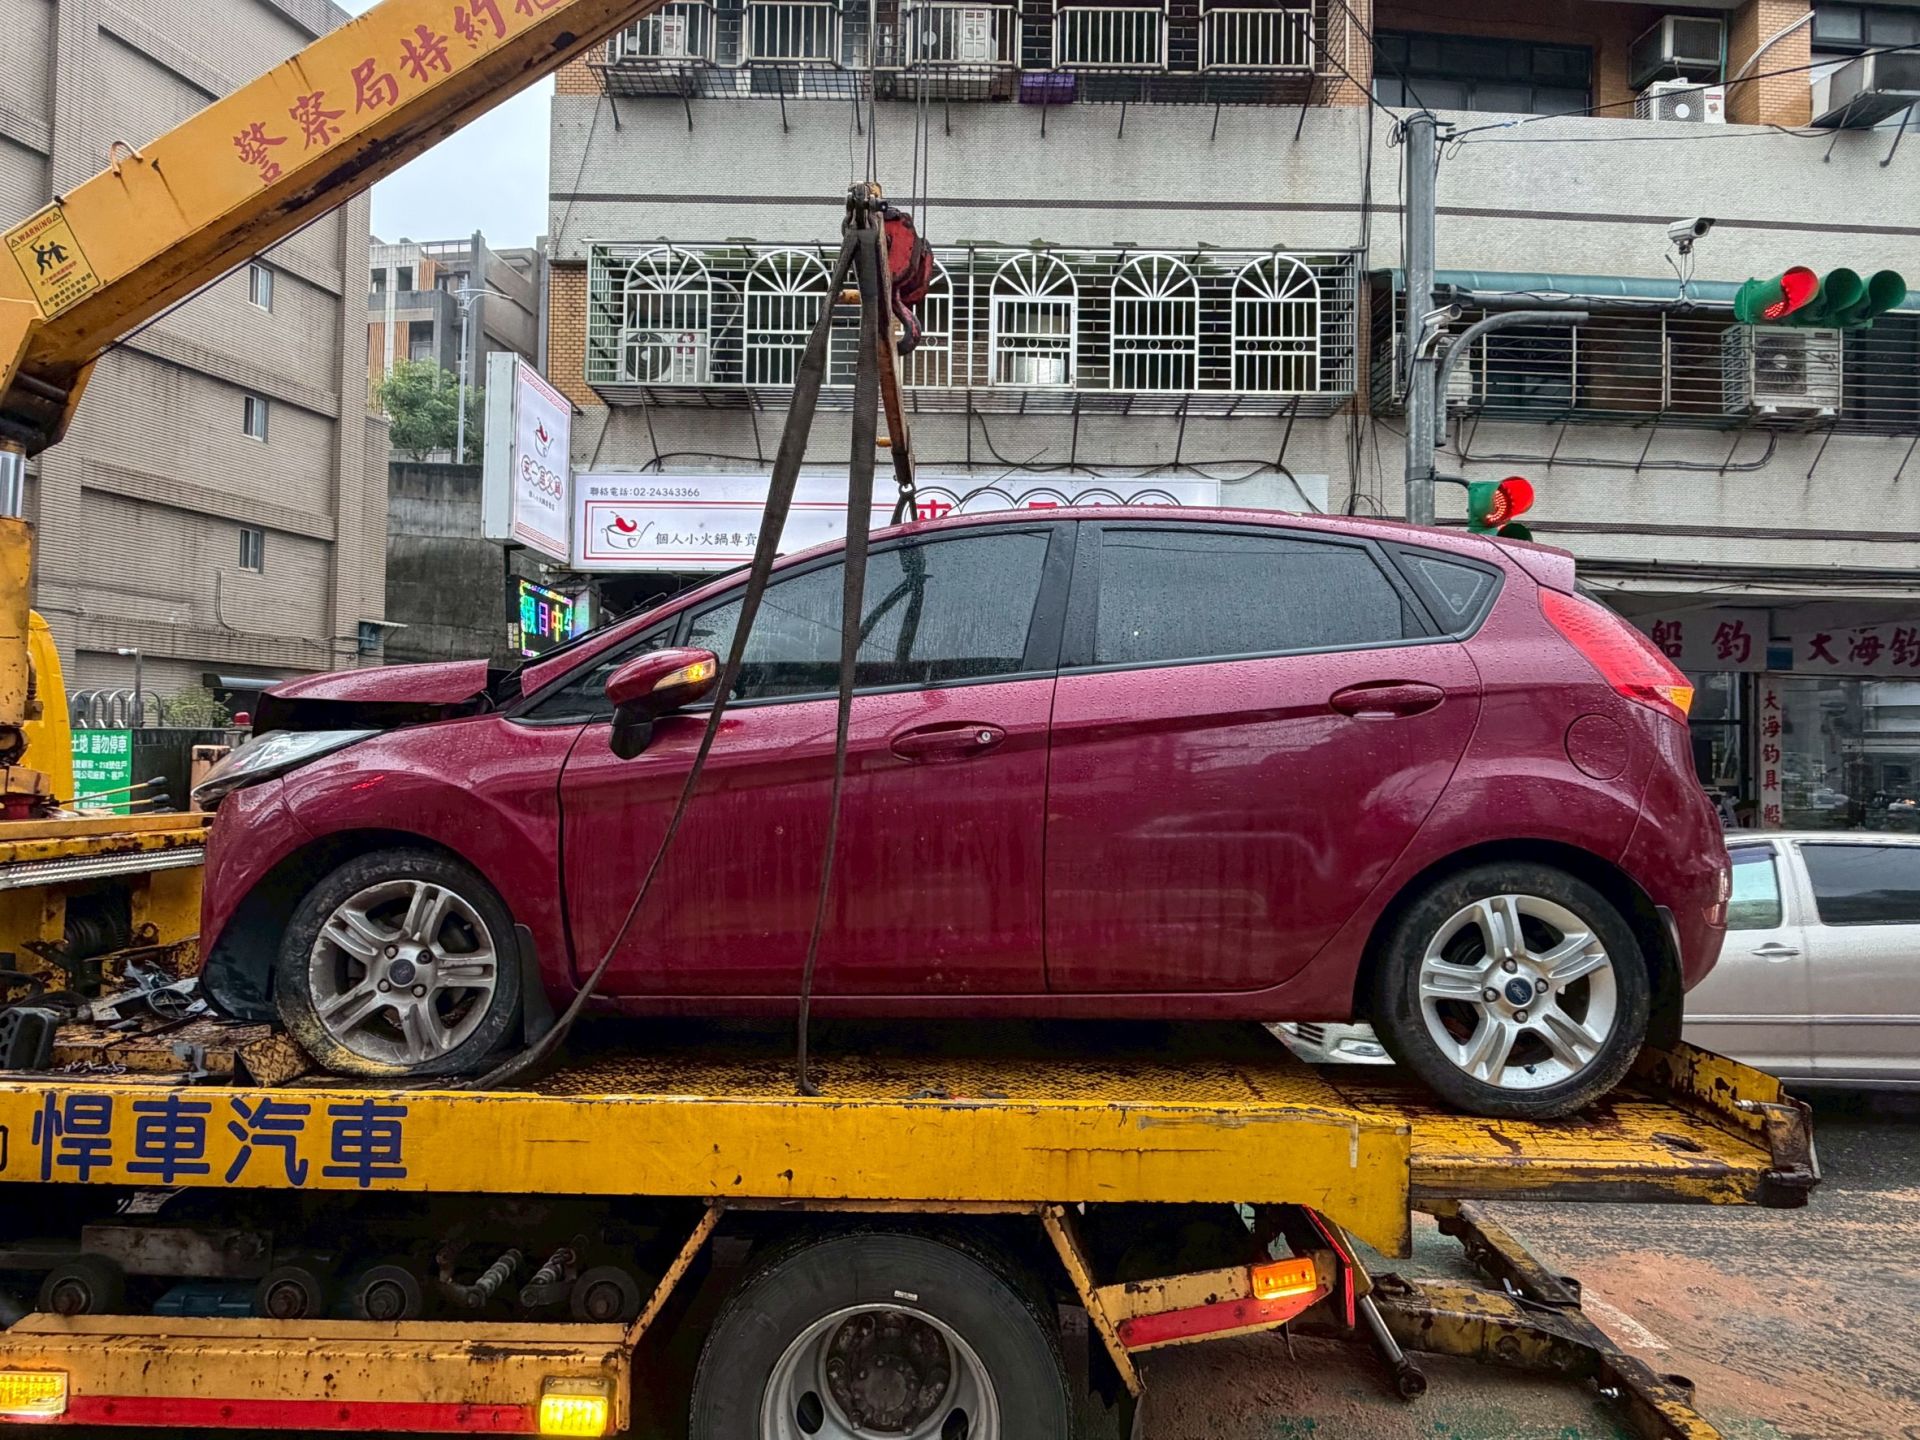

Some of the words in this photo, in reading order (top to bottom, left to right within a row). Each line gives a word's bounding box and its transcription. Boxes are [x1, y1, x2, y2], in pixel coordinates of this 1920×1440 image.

[17, 216, 54, 242] WARNING
[91, 734, 128, 754] 請勿停車
[31, 1092, 408, 1188] 悍車汽車
